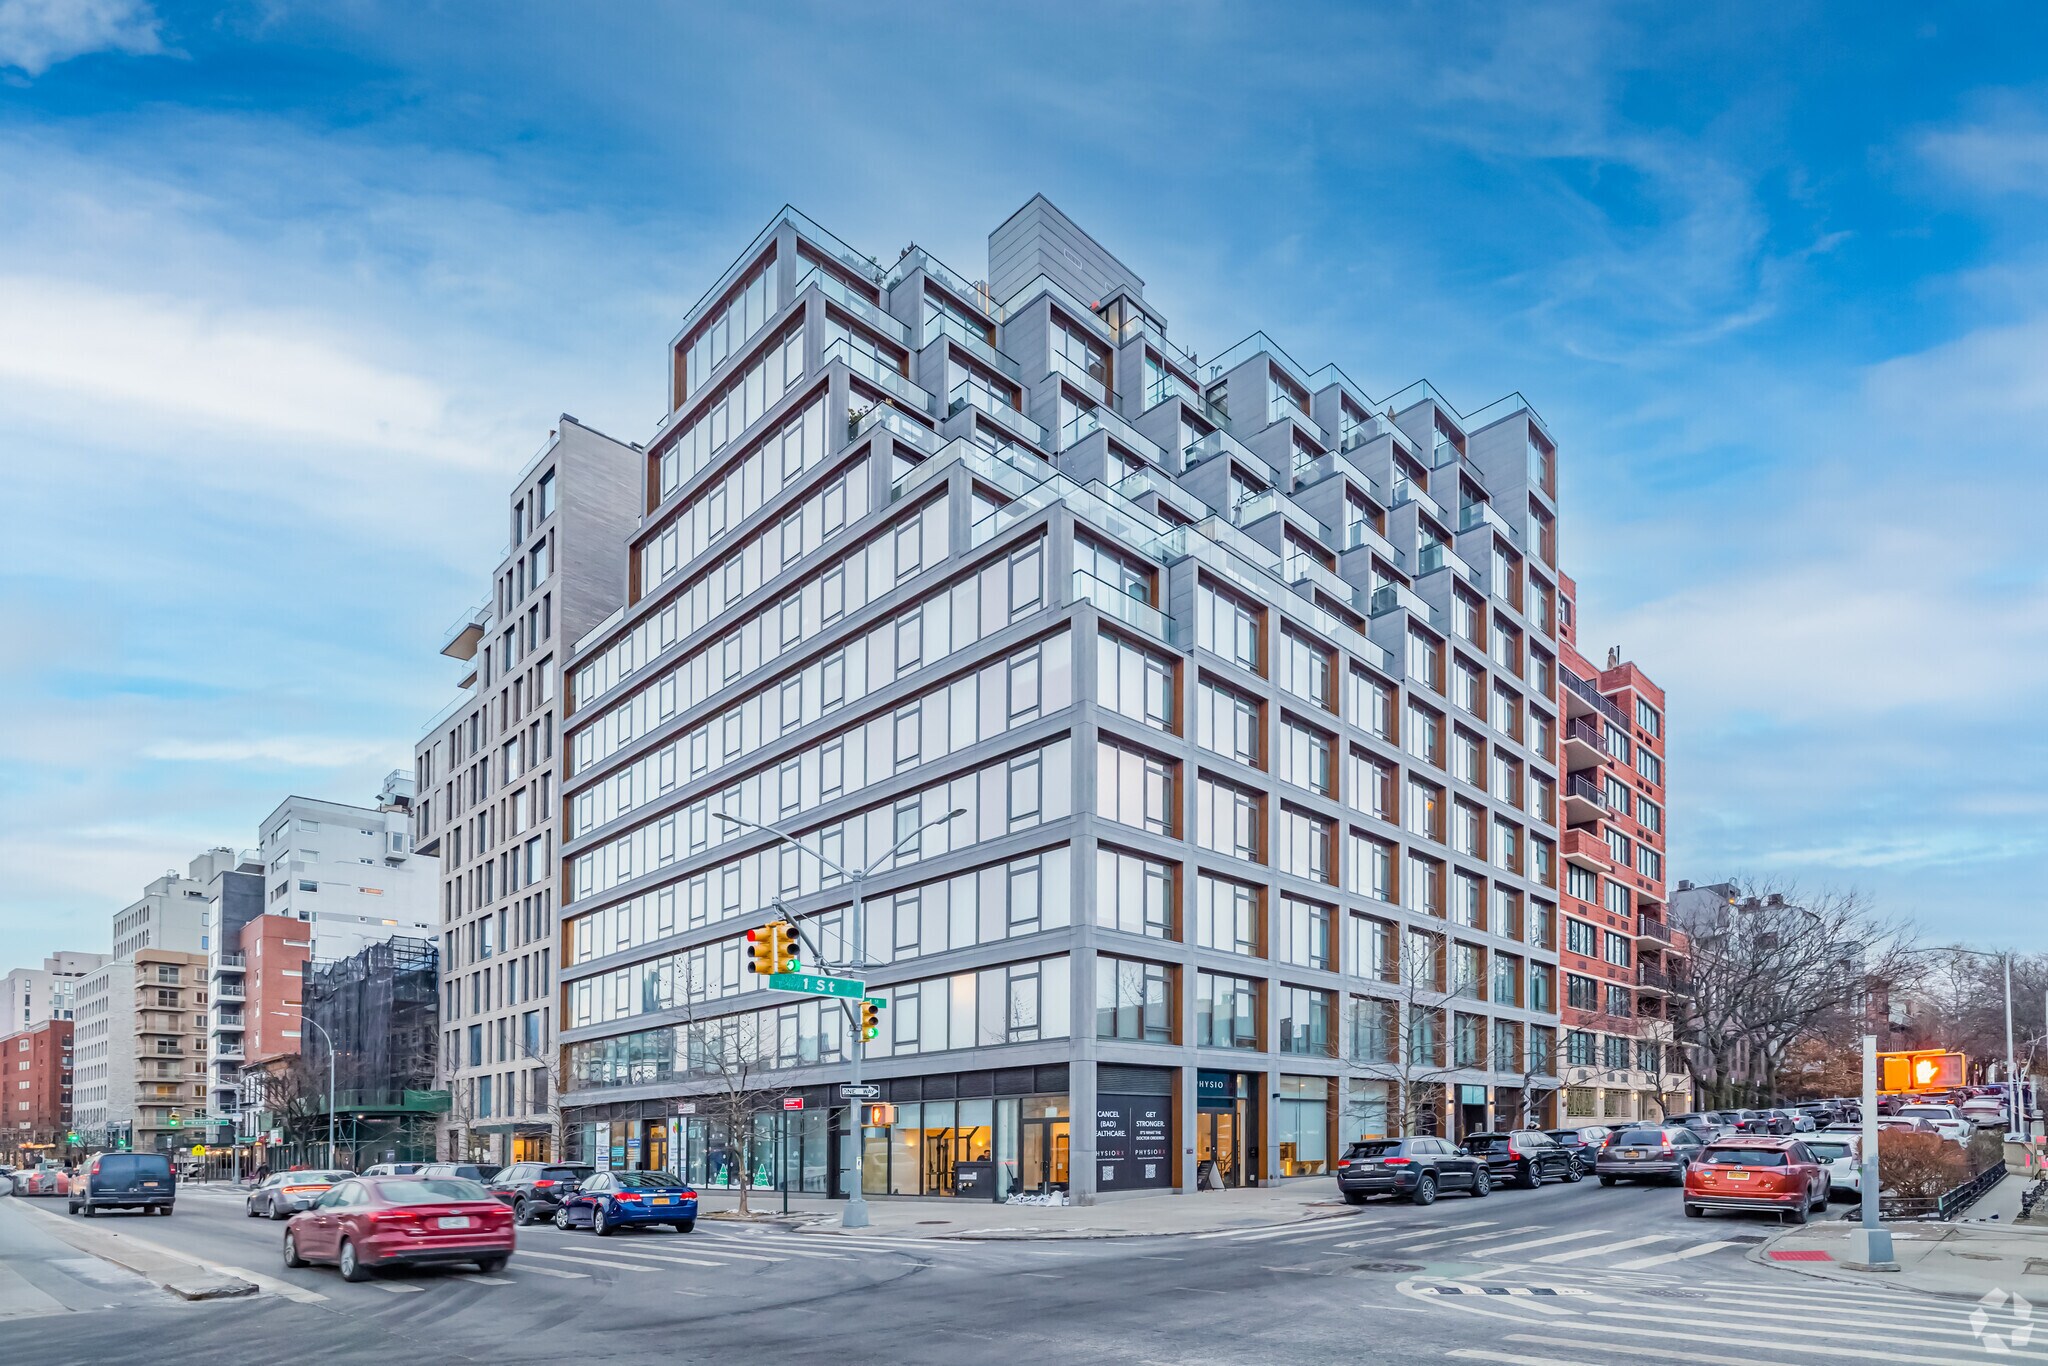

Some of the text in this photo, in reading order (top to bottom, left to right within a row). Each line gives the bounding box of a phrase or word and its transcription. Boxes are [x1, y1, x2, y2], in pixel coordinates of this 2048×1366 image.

[803, 977, 835, 993] 1 St
[1097, 1110, 1120, 1118] CANCEL
[1100, 1120, 1117, 1128] (BAD)
